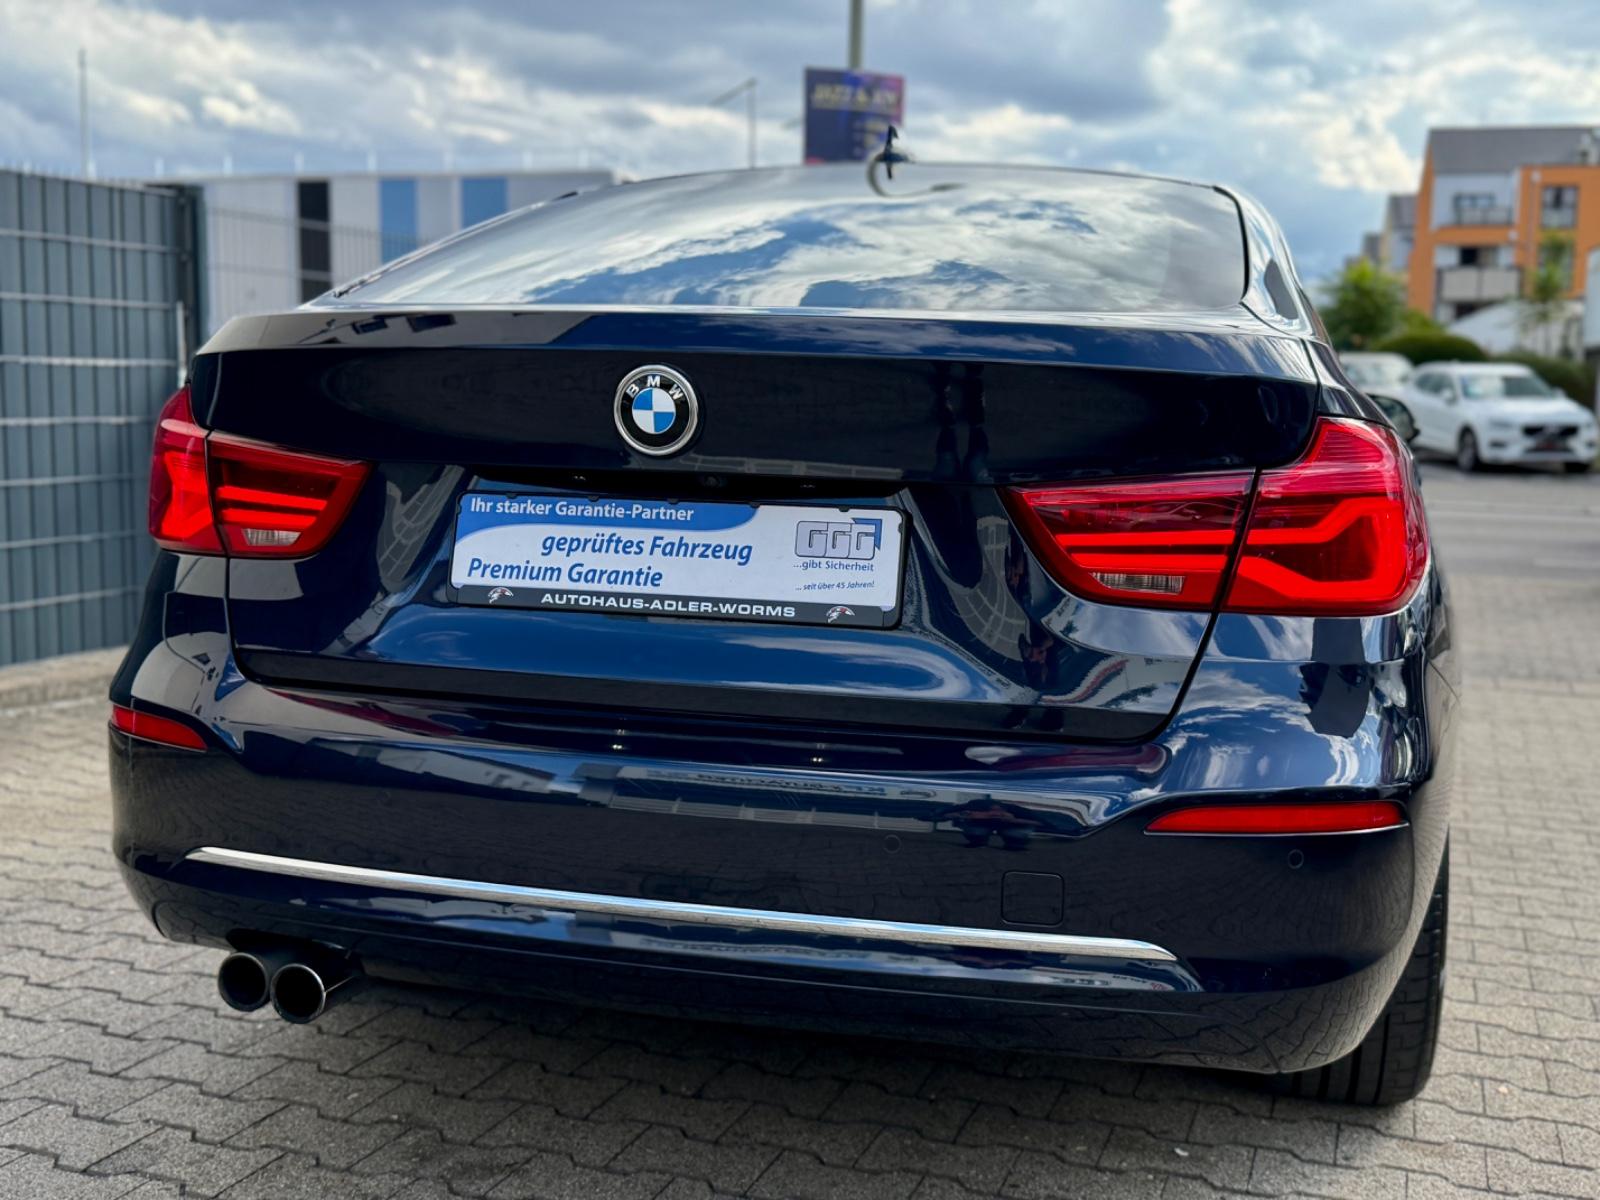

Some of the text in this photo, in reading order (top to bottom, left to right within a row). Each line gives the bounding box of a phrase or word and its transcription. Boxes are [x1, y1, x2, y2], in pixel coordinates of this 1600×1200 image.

[625, 375, 684, 400] BMW
[470, 496, 694, 521] Ihr starker Garantie-Partner
[541, 532, 753, 567] geprüftes Fahrzeug
[794, 518, 878, 561] GGG
[467, 557, 663, 587] Premium Garantie
[825, 560, 874, 572] Sicherheit
[817, 581, 835, 590] über
[846, 579, 875, 589] Jahren!
[540, 592, 796, 618] AUTOHAUS-ADLER-WORMS
